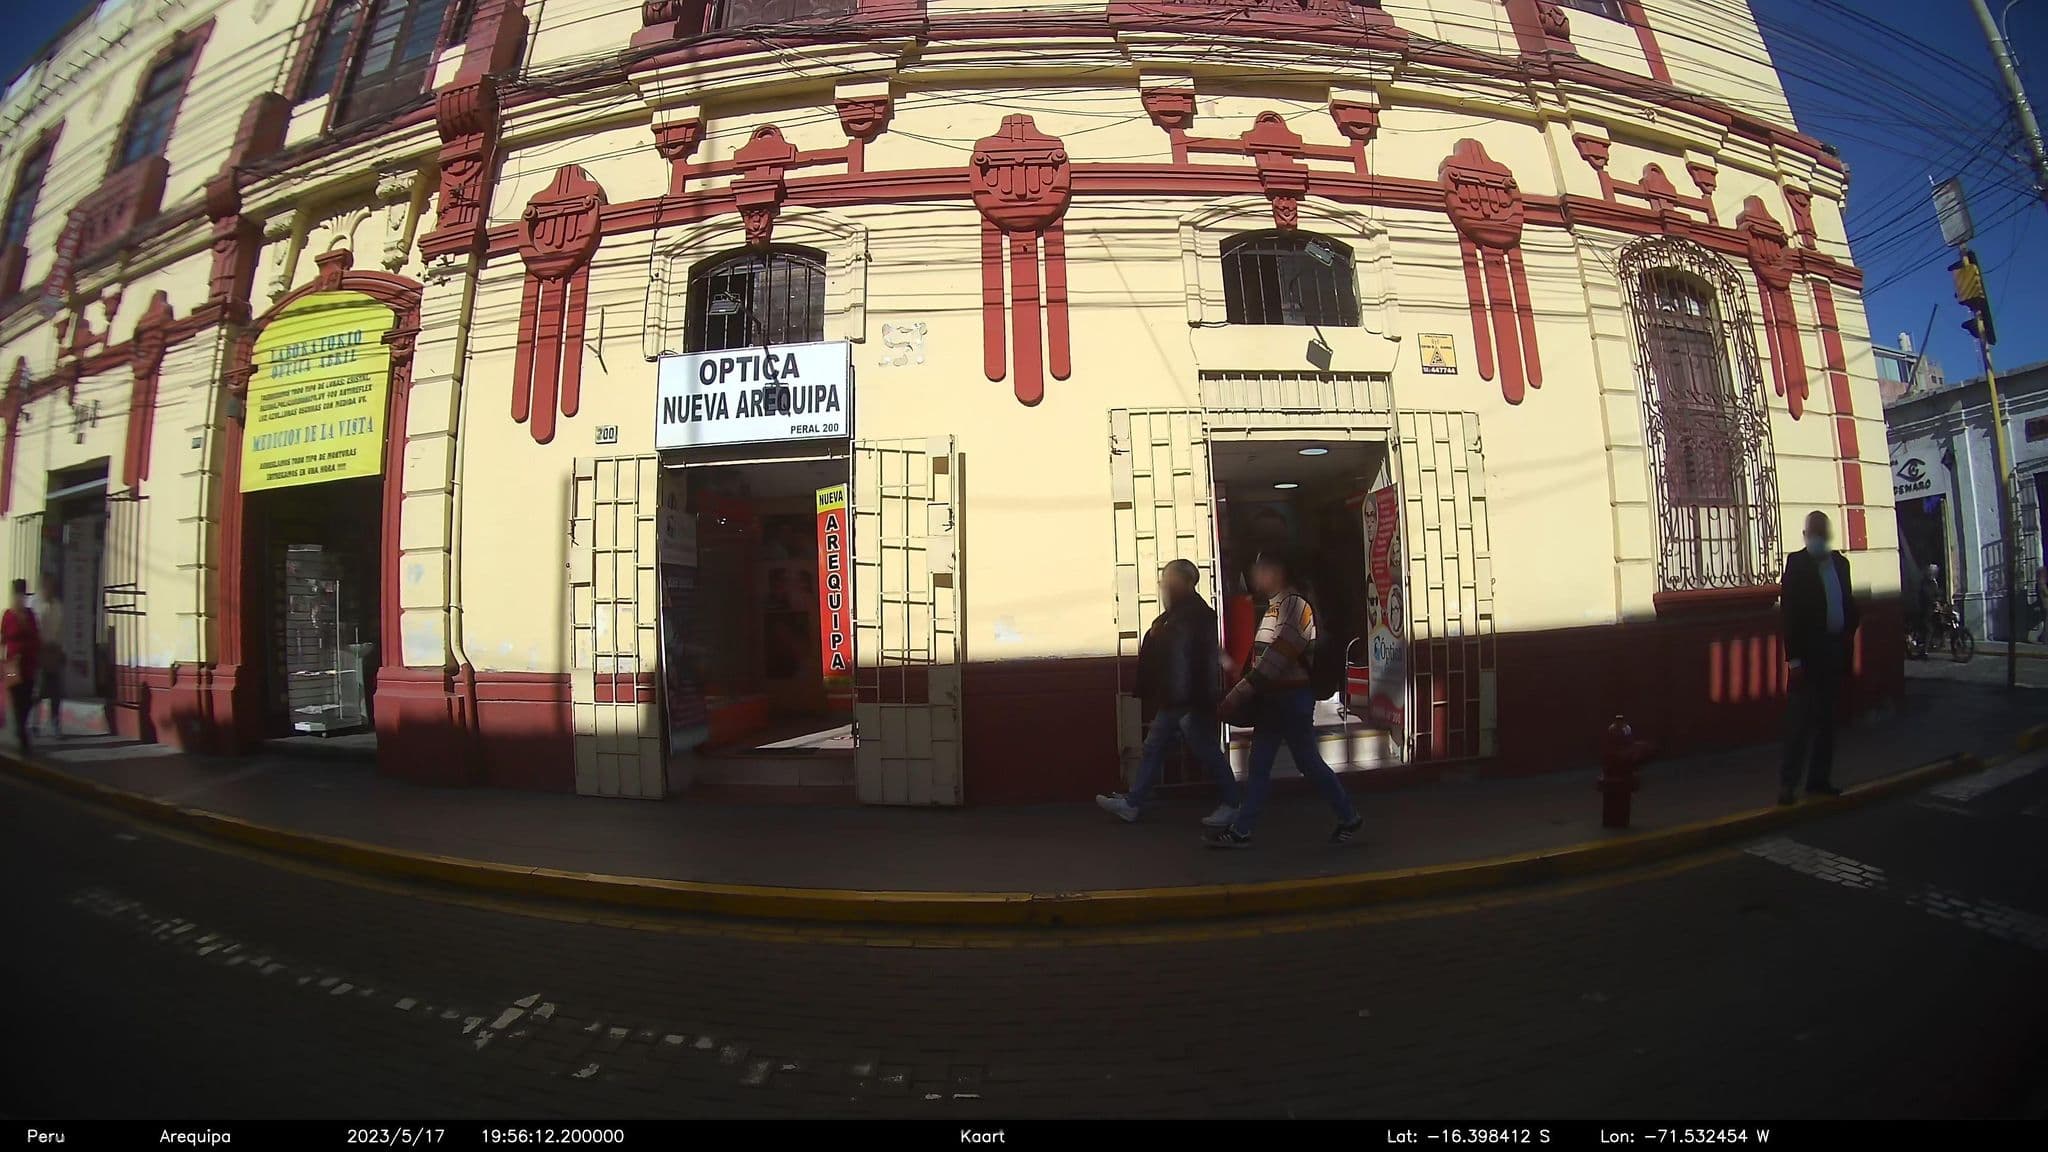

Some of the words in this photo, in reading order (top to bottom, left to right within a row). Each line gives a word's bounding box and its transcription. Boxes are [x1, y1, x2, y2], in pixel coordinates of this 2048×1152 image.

[699, 352, 800, 385] OPTICA
[662, 390, 730, 425] NUEVA
[735, 383, 841, 420] AREQUIPA
[252, 427, 302, 452] MEDICION
[303, 425, 318, 444] DE
[320, 423, 335, 440] LA
[338, 416, 374, 437] VISTA
[790, 423, 821, 435] PERAL
[822, 423, 839, 433] 200
[819, 490, 844, 506] NUEVA
[825, 513, 845, 670] AREQUIPA
